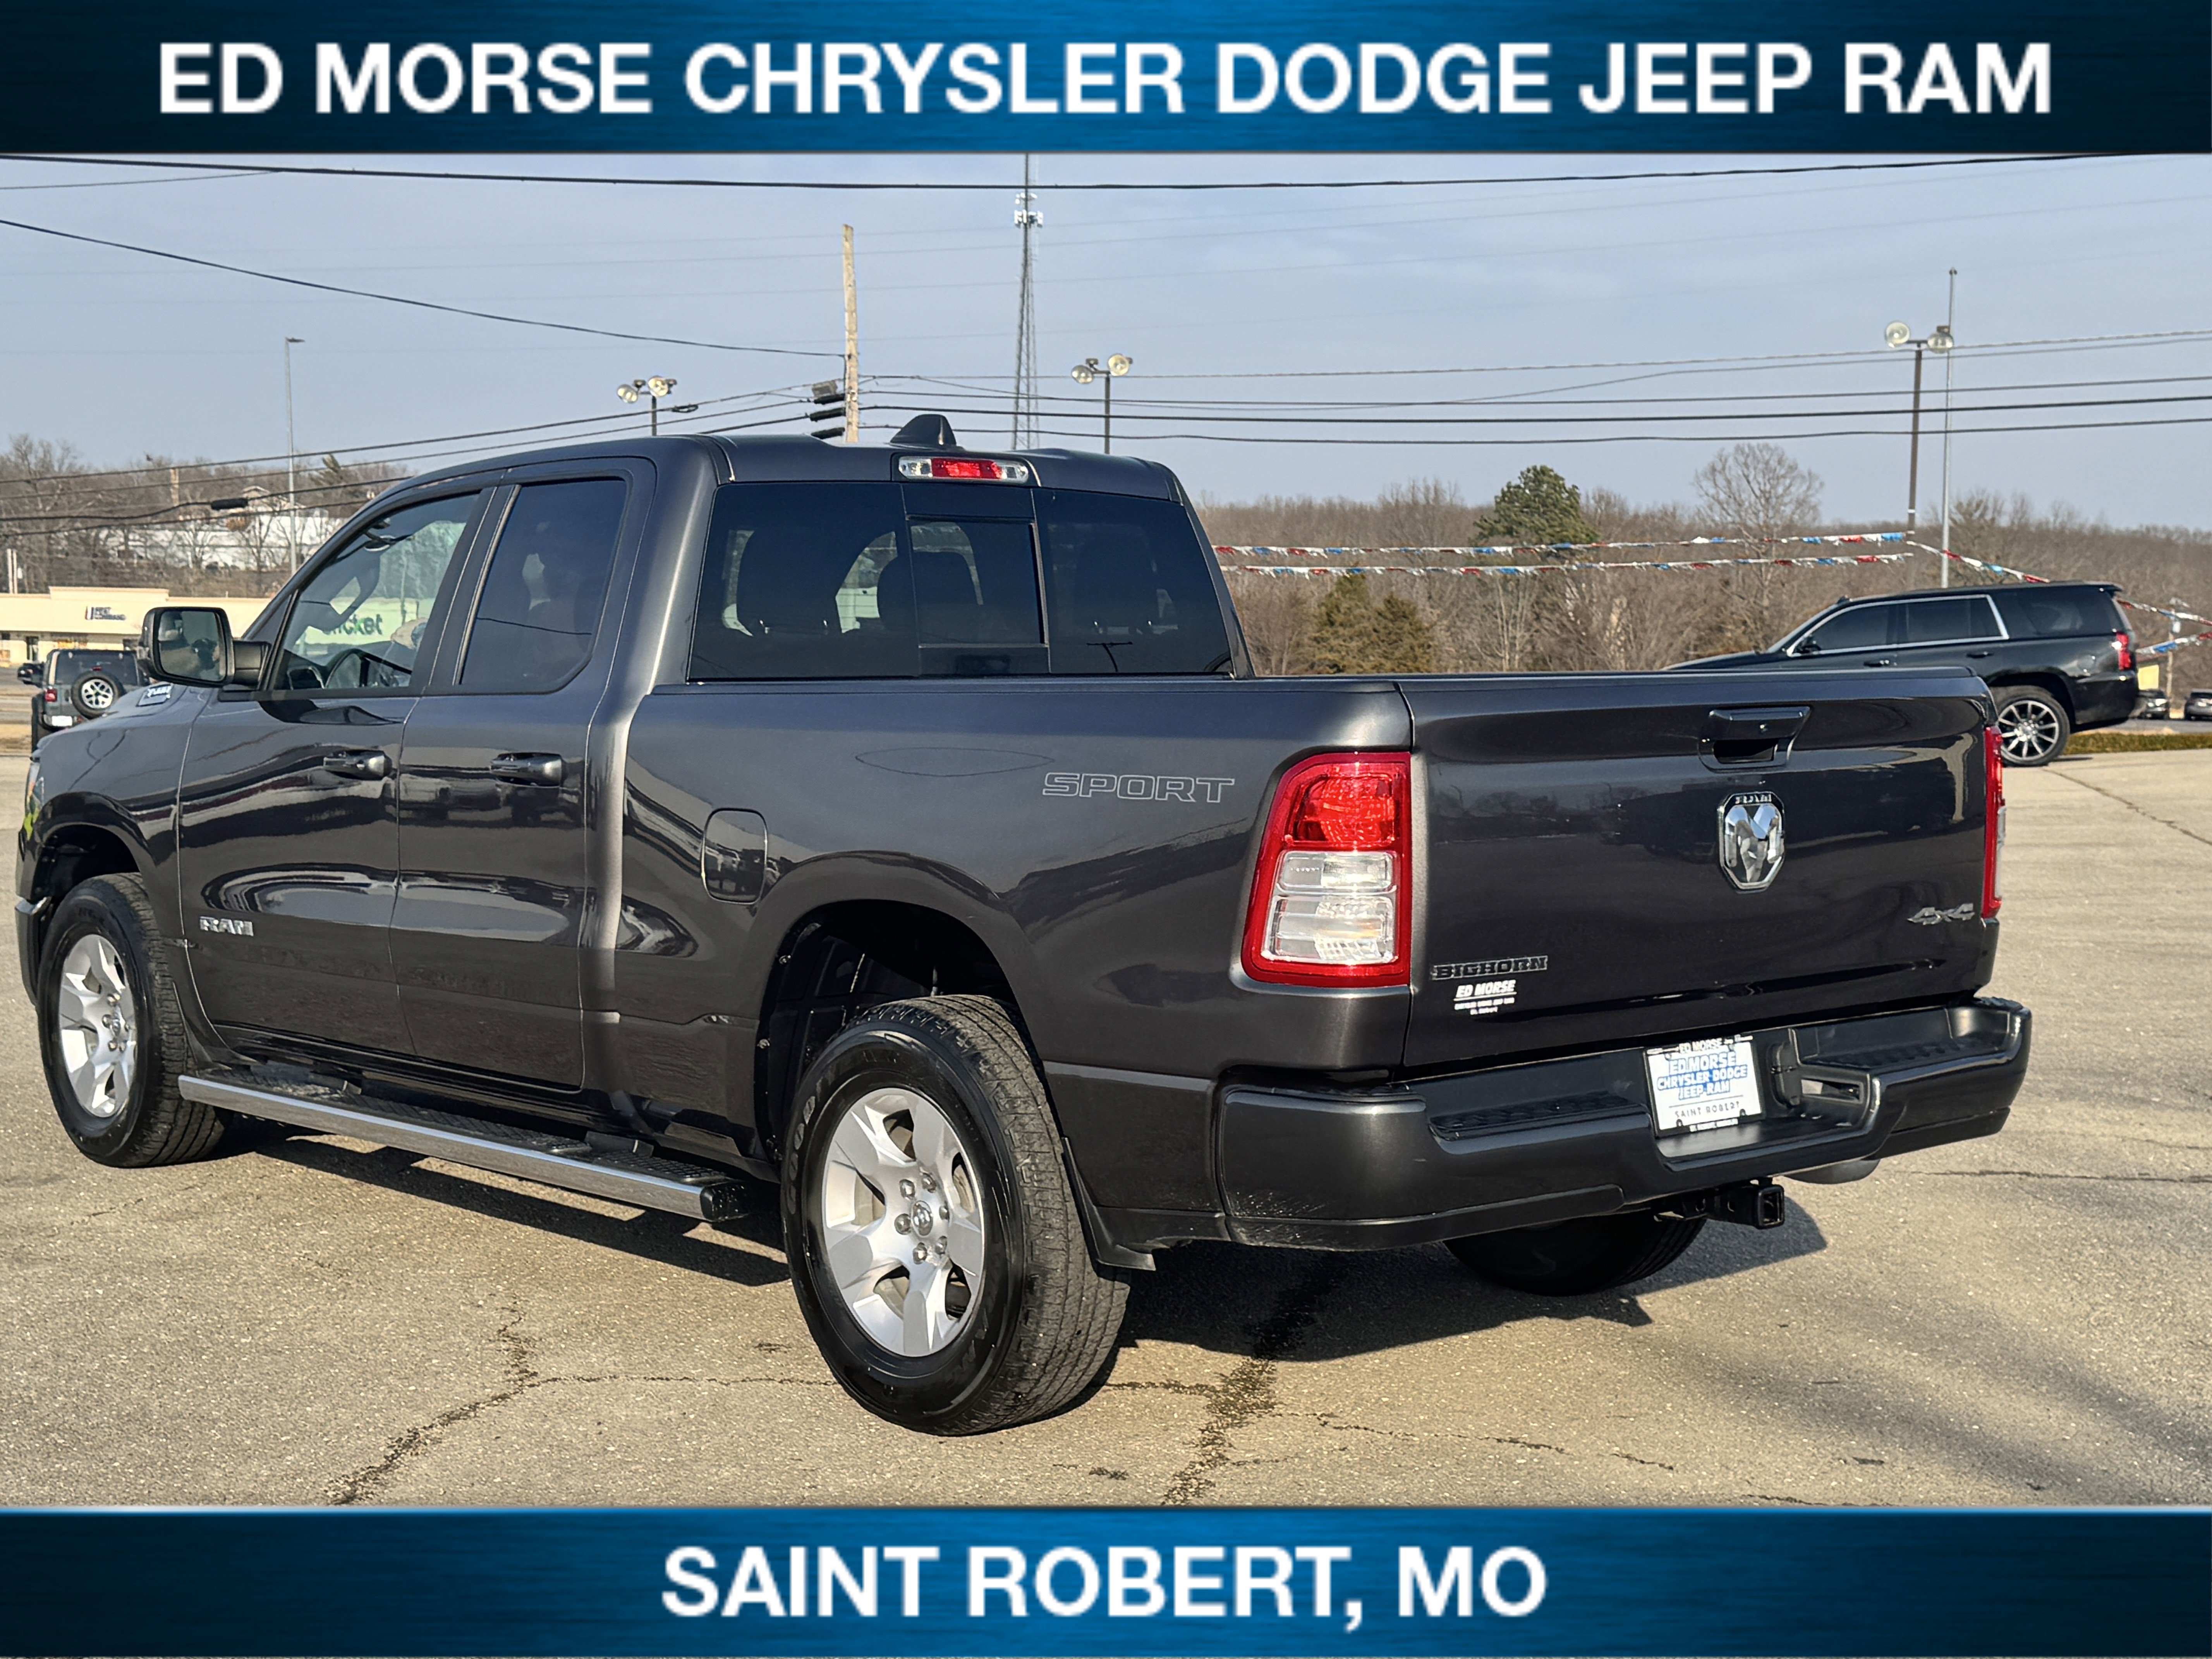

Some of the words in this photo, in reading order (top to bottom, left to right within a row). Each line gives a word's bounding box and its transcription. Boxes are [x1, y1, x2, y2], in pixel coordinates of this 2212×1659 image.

[1042, 772, 1235, 803] SPORT
[200, 916, 254, 936] RAM
[1430, 955, 1548, 980] BIGHORN
[1455, 984, 1473, 998] ED
[1474, 980, 1516, 996] MORSE
[1679, 1042, 1692, 1053] ED
[1669, 1058, 1686, 1075] ED
[1688, 1051, 1736, 1072] MORSE
[1657, 1071, 1710, 1091] CHRYSLER
[1712, 1065, 1747, 1081] DODGE
[1679, 1084, 1704, 1100] JEEP
[1706, 1080, 1730, 1096] RAM
[1675, 1107, 1701, 1118] SAINT
